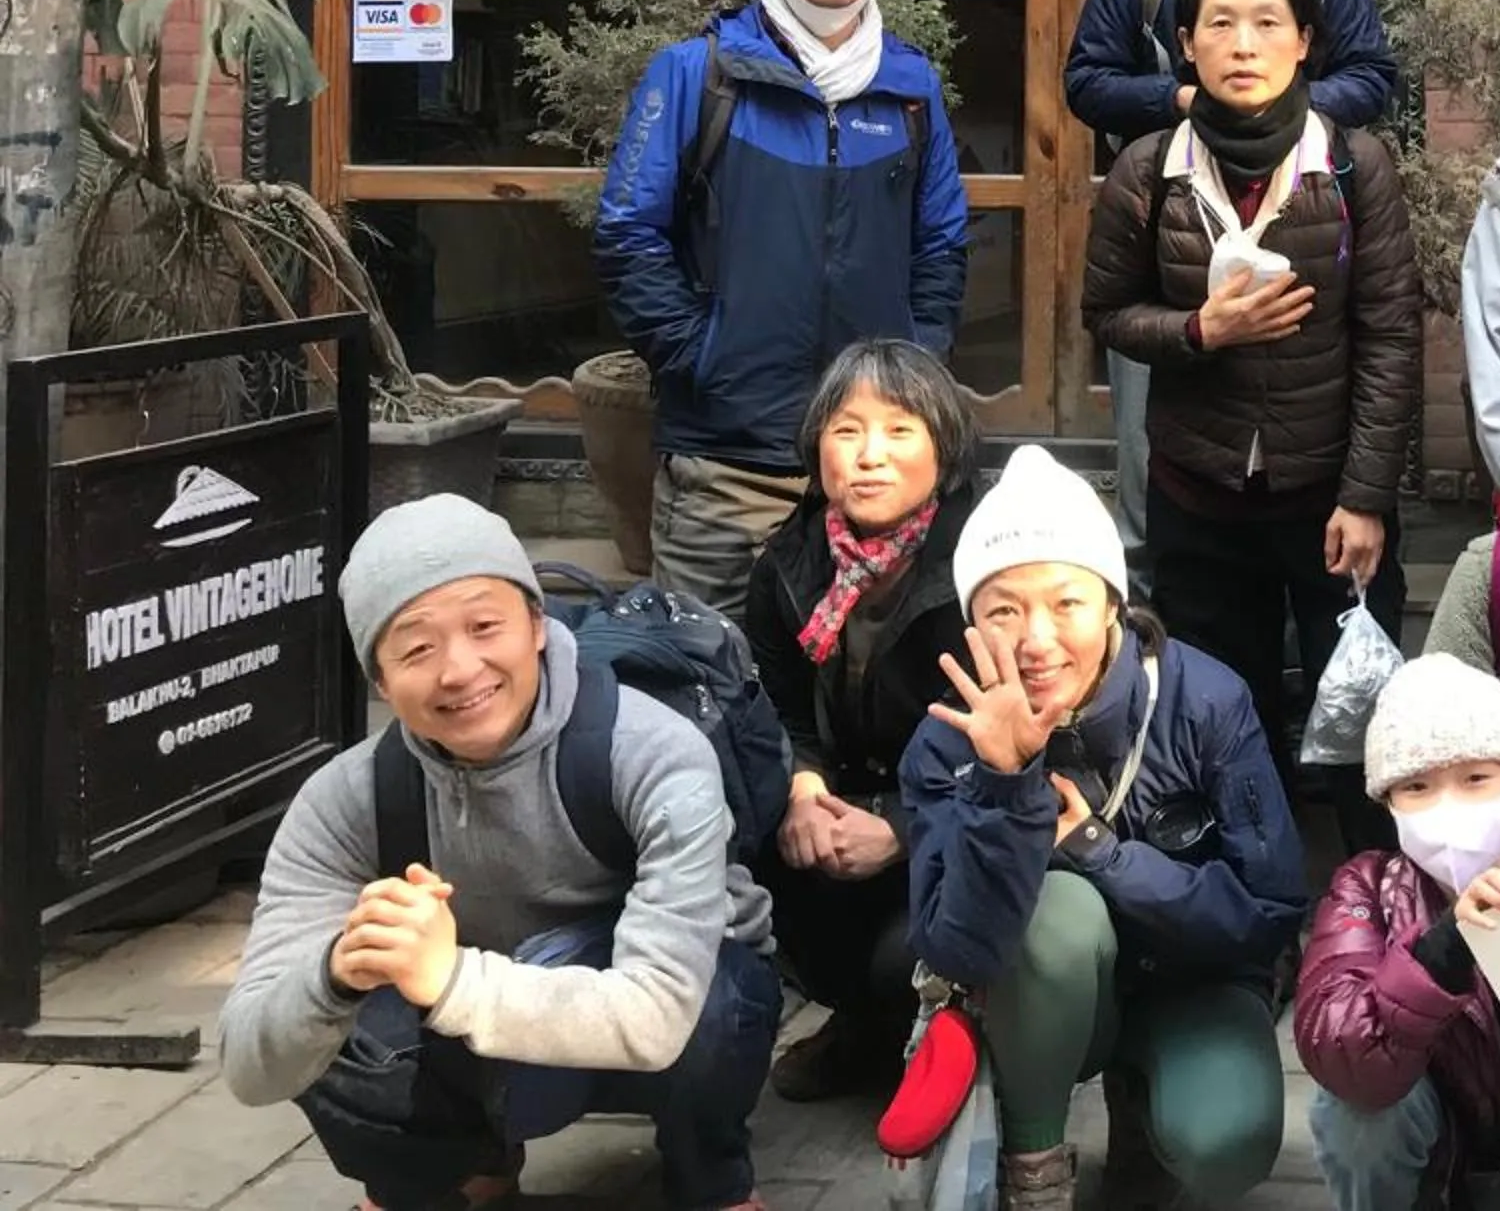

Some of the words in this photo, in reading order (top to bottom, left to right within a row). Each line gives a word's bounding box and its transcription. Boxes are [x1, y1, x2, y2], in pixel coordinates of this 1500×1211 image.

[365, 9, 399, 24] VISA
[85, 596, 166, 670] HOTEL
[164, 545, 325, 643] VINTAGEHOME
[200, 643, 282, 690] BHAKTAPUR
